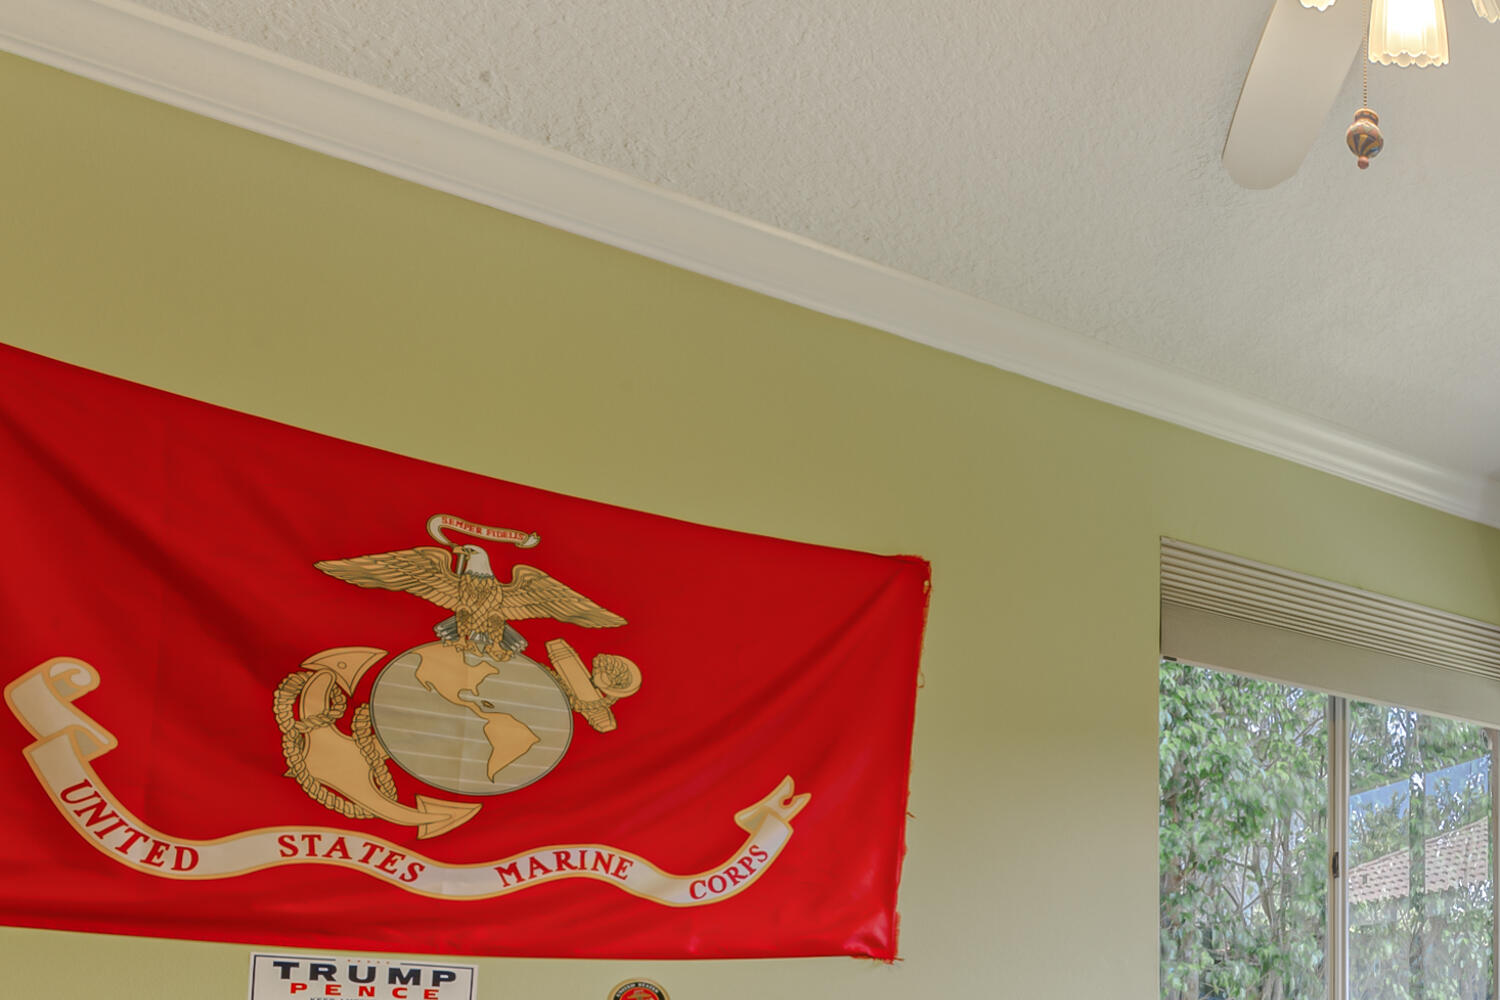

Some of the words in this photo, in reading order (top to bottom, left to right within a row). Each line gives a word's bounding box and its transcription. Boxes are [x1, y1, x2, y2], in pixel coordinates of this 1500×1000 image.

[442, 516, 482, 534] SEMPER
[486, 528, 525, 540] FIDELIS
[60, 779, 199, 872] UNITED
[277, 834, 425, 883] STATES
[494, 849, 634, 887] MARINE
[689, 844, 768, 900] CORPS
[273, 961, 456, 987] TRUMP
[290, 983, 440, 1000] PENCE
